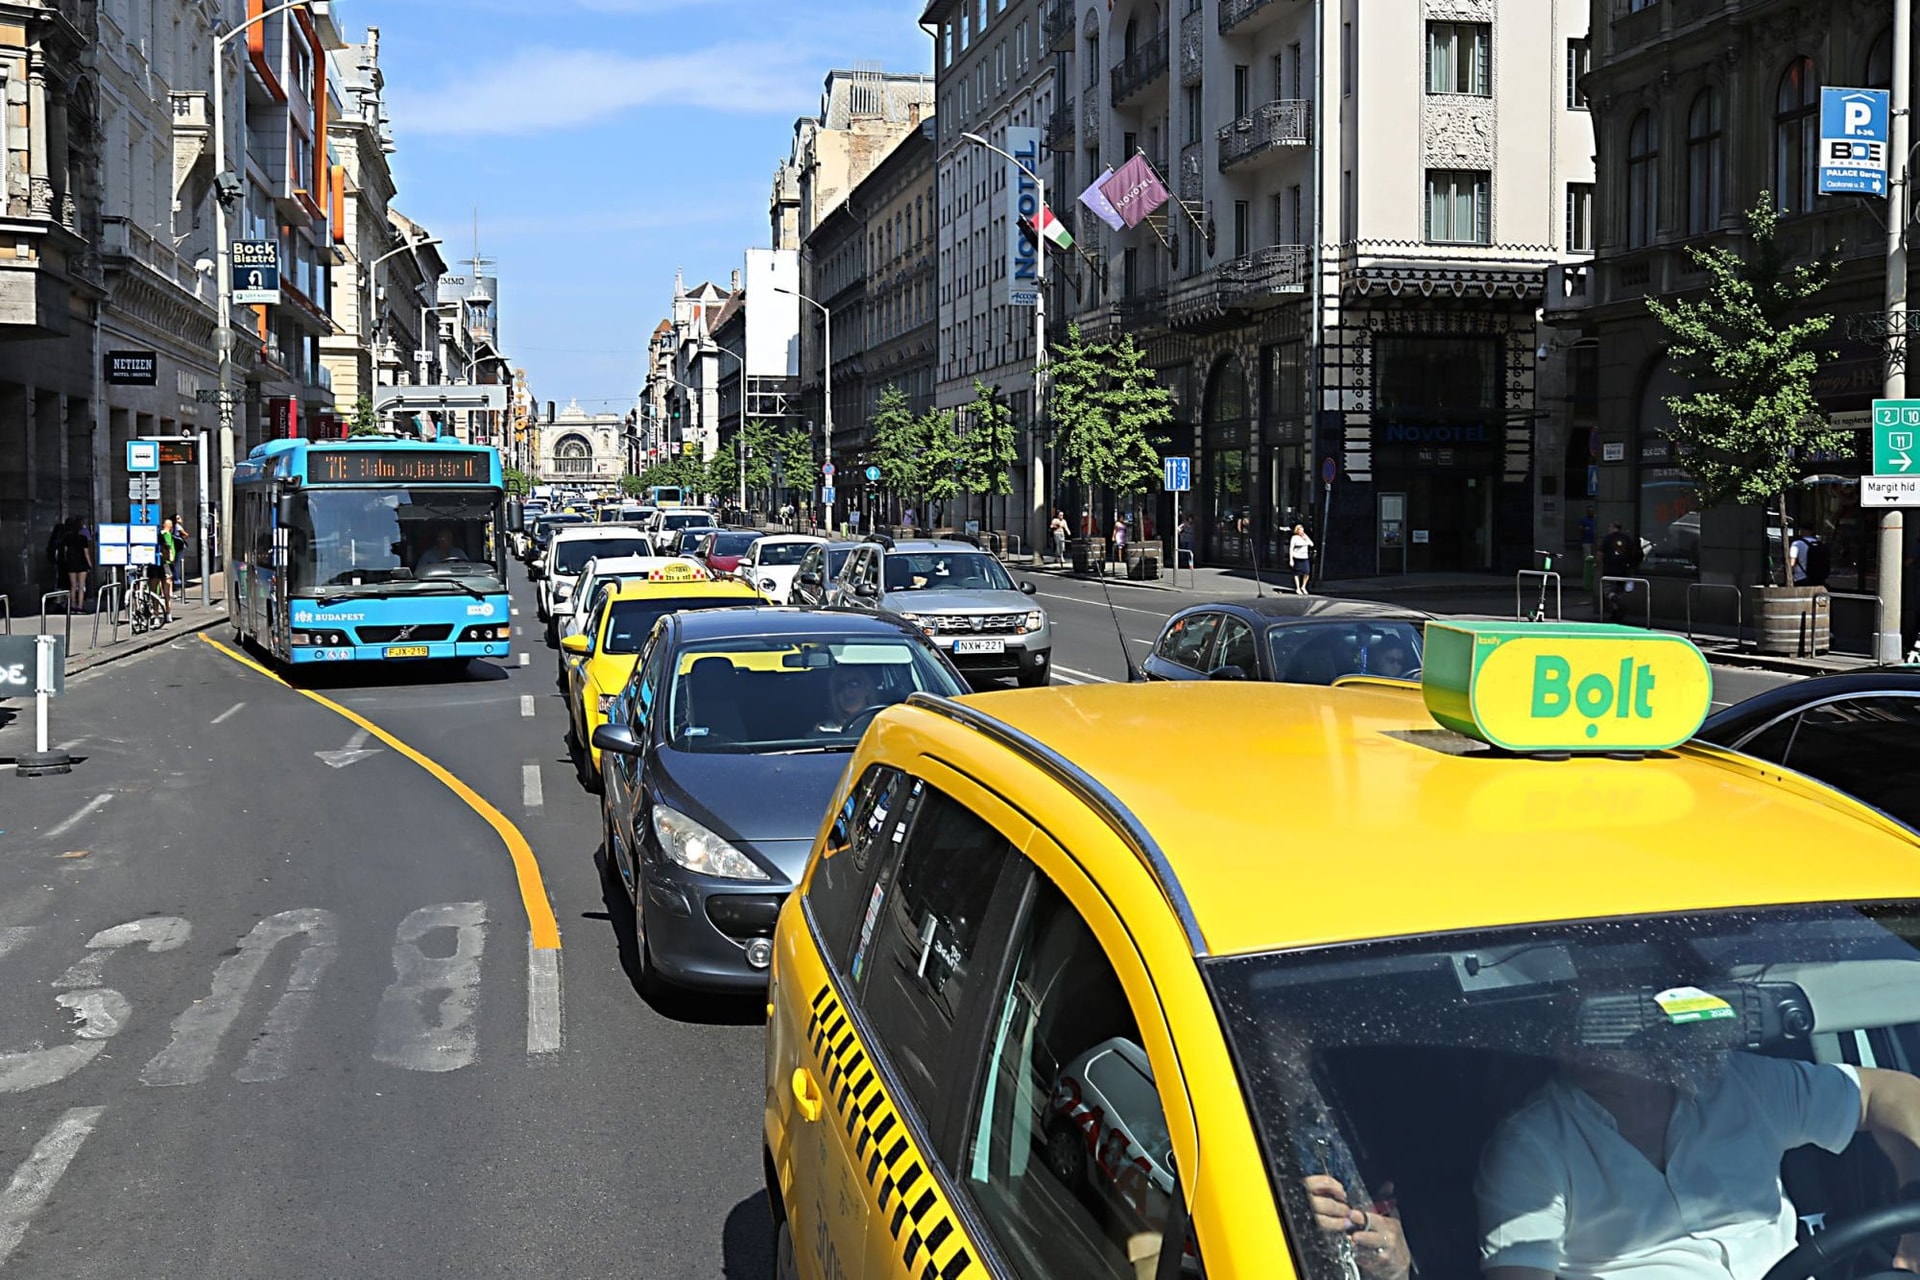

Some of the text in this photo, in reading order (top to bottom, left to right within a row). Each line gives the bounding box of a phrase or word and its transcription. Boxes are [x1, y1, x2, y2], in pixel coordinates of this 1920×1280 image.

[1845, 101, 1872, 135] P
[1826, 169, 1858, 177] PALACE
[1116, 178, 1153, 209] NOVOTEL
[1014, 140, 1036, 280] NOOTEL
[233, 242, 276, 255] Bock
[233, 253, 276, 264] Bisztró
[113, 358, 153, 371] NETIZEN
[1884, 410, 1919, 423] 2 10
[1386, 423, 1489, 442] NOVOTEL
[1896, 435, 1905, 448] 11
[1868, 482, 1898, 493] Margit
[315, 613, 365, 622] BUDAPEST
[388, 647, 426, 657] FJX-219
[960, 641, 1002, 650] NXW-221
[1531, 655, 1655, 720] Bolt
